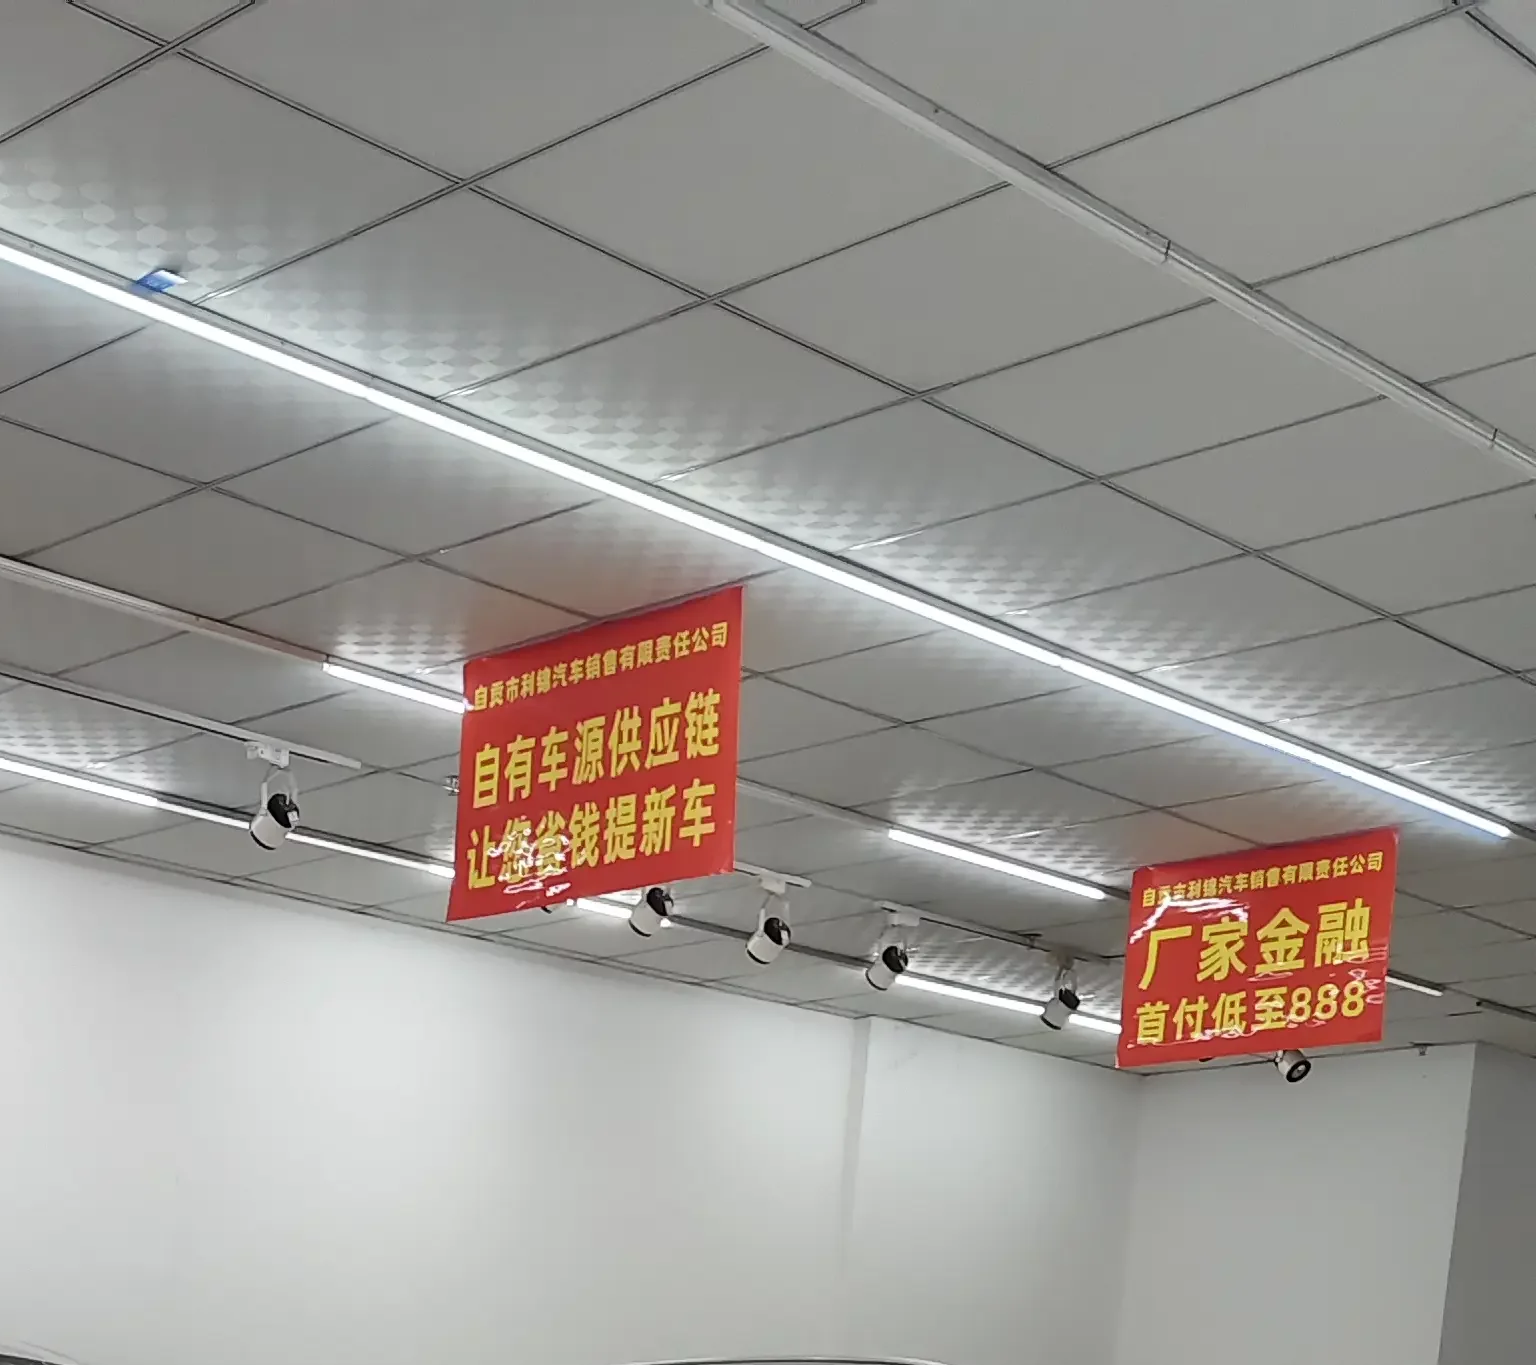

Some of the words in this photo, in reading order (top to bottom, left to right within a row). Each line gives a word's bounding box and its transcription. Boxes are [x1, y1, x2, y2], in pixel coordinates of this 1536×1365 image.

[473, 688, 720, 809] 自有车源供应链
[467, 778, 715, 890] 让您省钱提新车
[1138, 898, 1371, 990] 厂家金融
[1136, 981, 1365, 1045] 首付低至888
